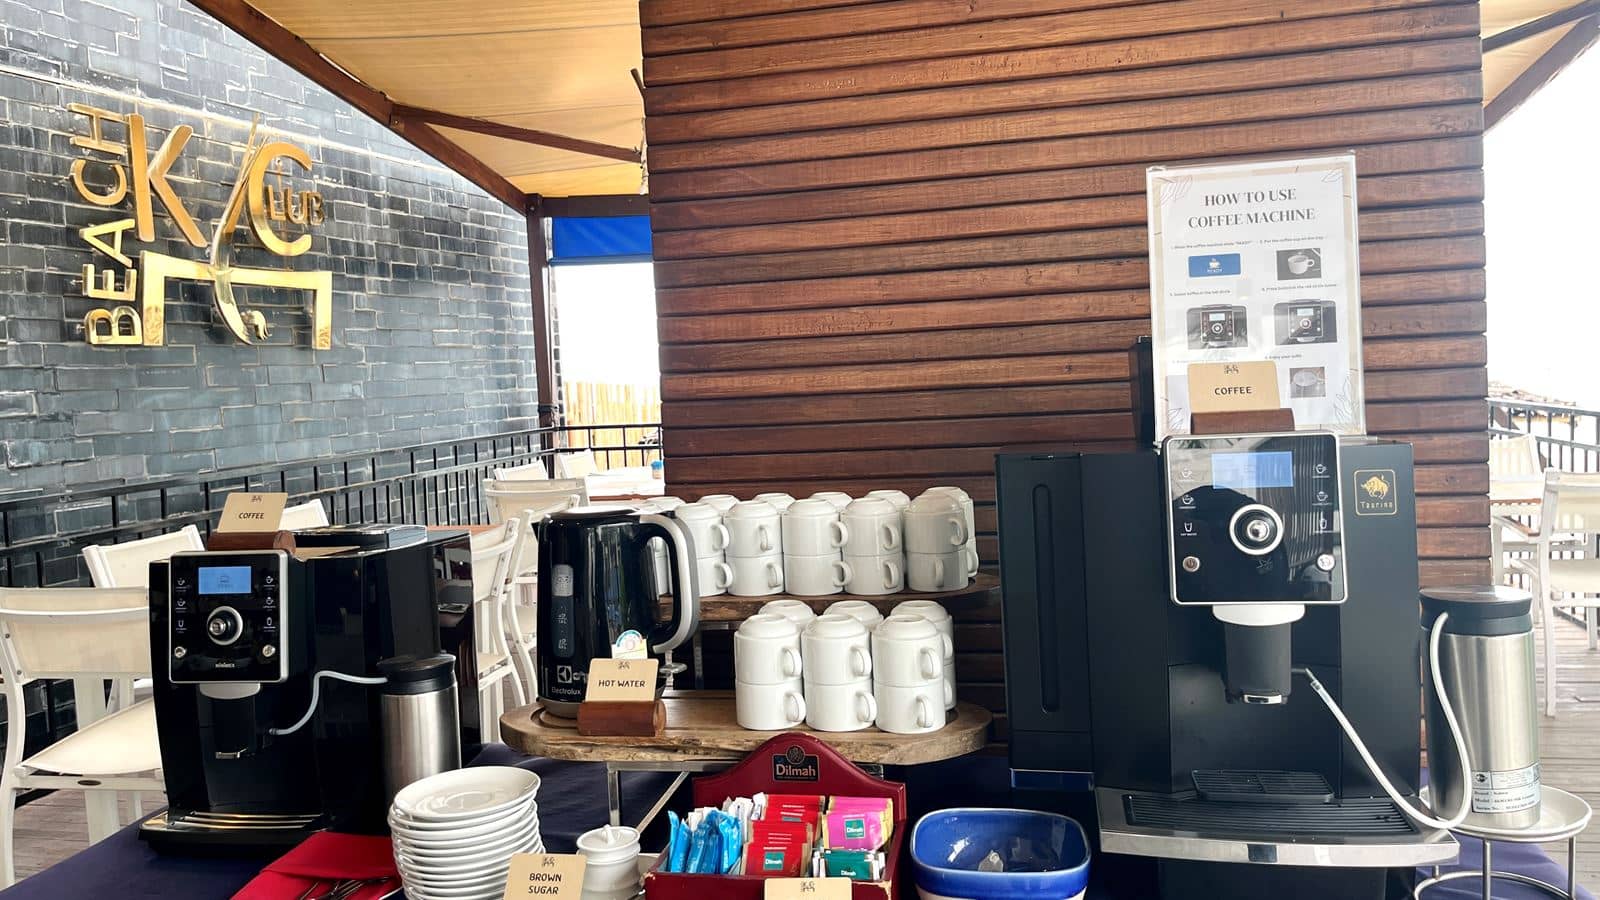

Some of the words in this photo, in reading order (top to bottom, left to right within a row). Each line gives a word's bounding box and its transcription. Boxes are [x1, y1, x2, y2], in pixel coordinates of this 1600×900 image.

[1204, 192, 1239, 207] HOW
[1245, 190, 1266, 204] TO
[1269, 188, 1297, 202] USE
[66, 102, 142, 345] BEACH
[1188, 213, 1244, 229] COFFEE
[1246, 208, 1315, 225] MACHINE
[1214, 386, 1253, 396] COFFEE
[238, 512, 265, 520] COFFEE
[598, 679, 616, 688] HOT
[618, 679, 646, 688] WATER
[551, 686, 582, 696] Electrolux
[775, 763, 817, 777] Dilmah
[529, 872, 562, 882] BROWN
[528, 885, 559, 895] SUGAR
